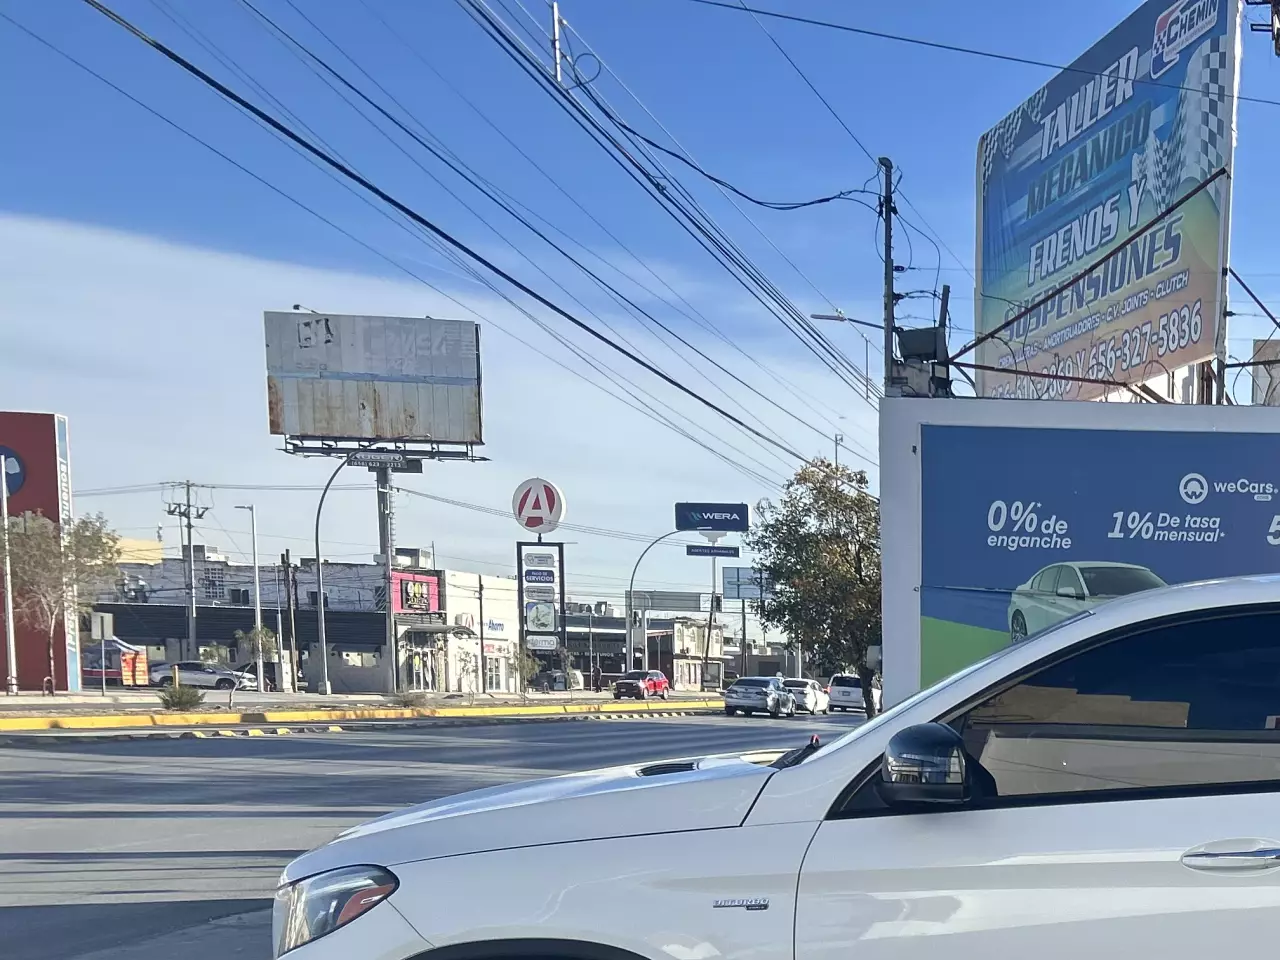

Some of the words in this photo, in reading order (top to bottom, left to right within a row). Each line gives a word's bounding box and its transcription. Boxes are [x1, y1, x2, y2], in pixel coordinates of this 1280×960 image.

[1040, 46, 1139, 161] TALLER
[1027, 192, 1121, 288] FRENOS
[1127, 175, 1147, 230] Y
[1002, 211, 1186, 341] SUSPENSIONES
[1121, 290, 1150, 315] JOINTS
[1155, 268, 1190, 299] CLUTCH
[1088, 298, 1203, 379] 656-327-5836
[702, 512, 740, 520] WERA
[1040, 514, 1069, 535] de
[1107, 510, 1154, 540] 1%
[1157, 512, 1180, 528] De
[1184, 513, 1221, 529] tasa
[987, 533, 1072, 551] enganche
